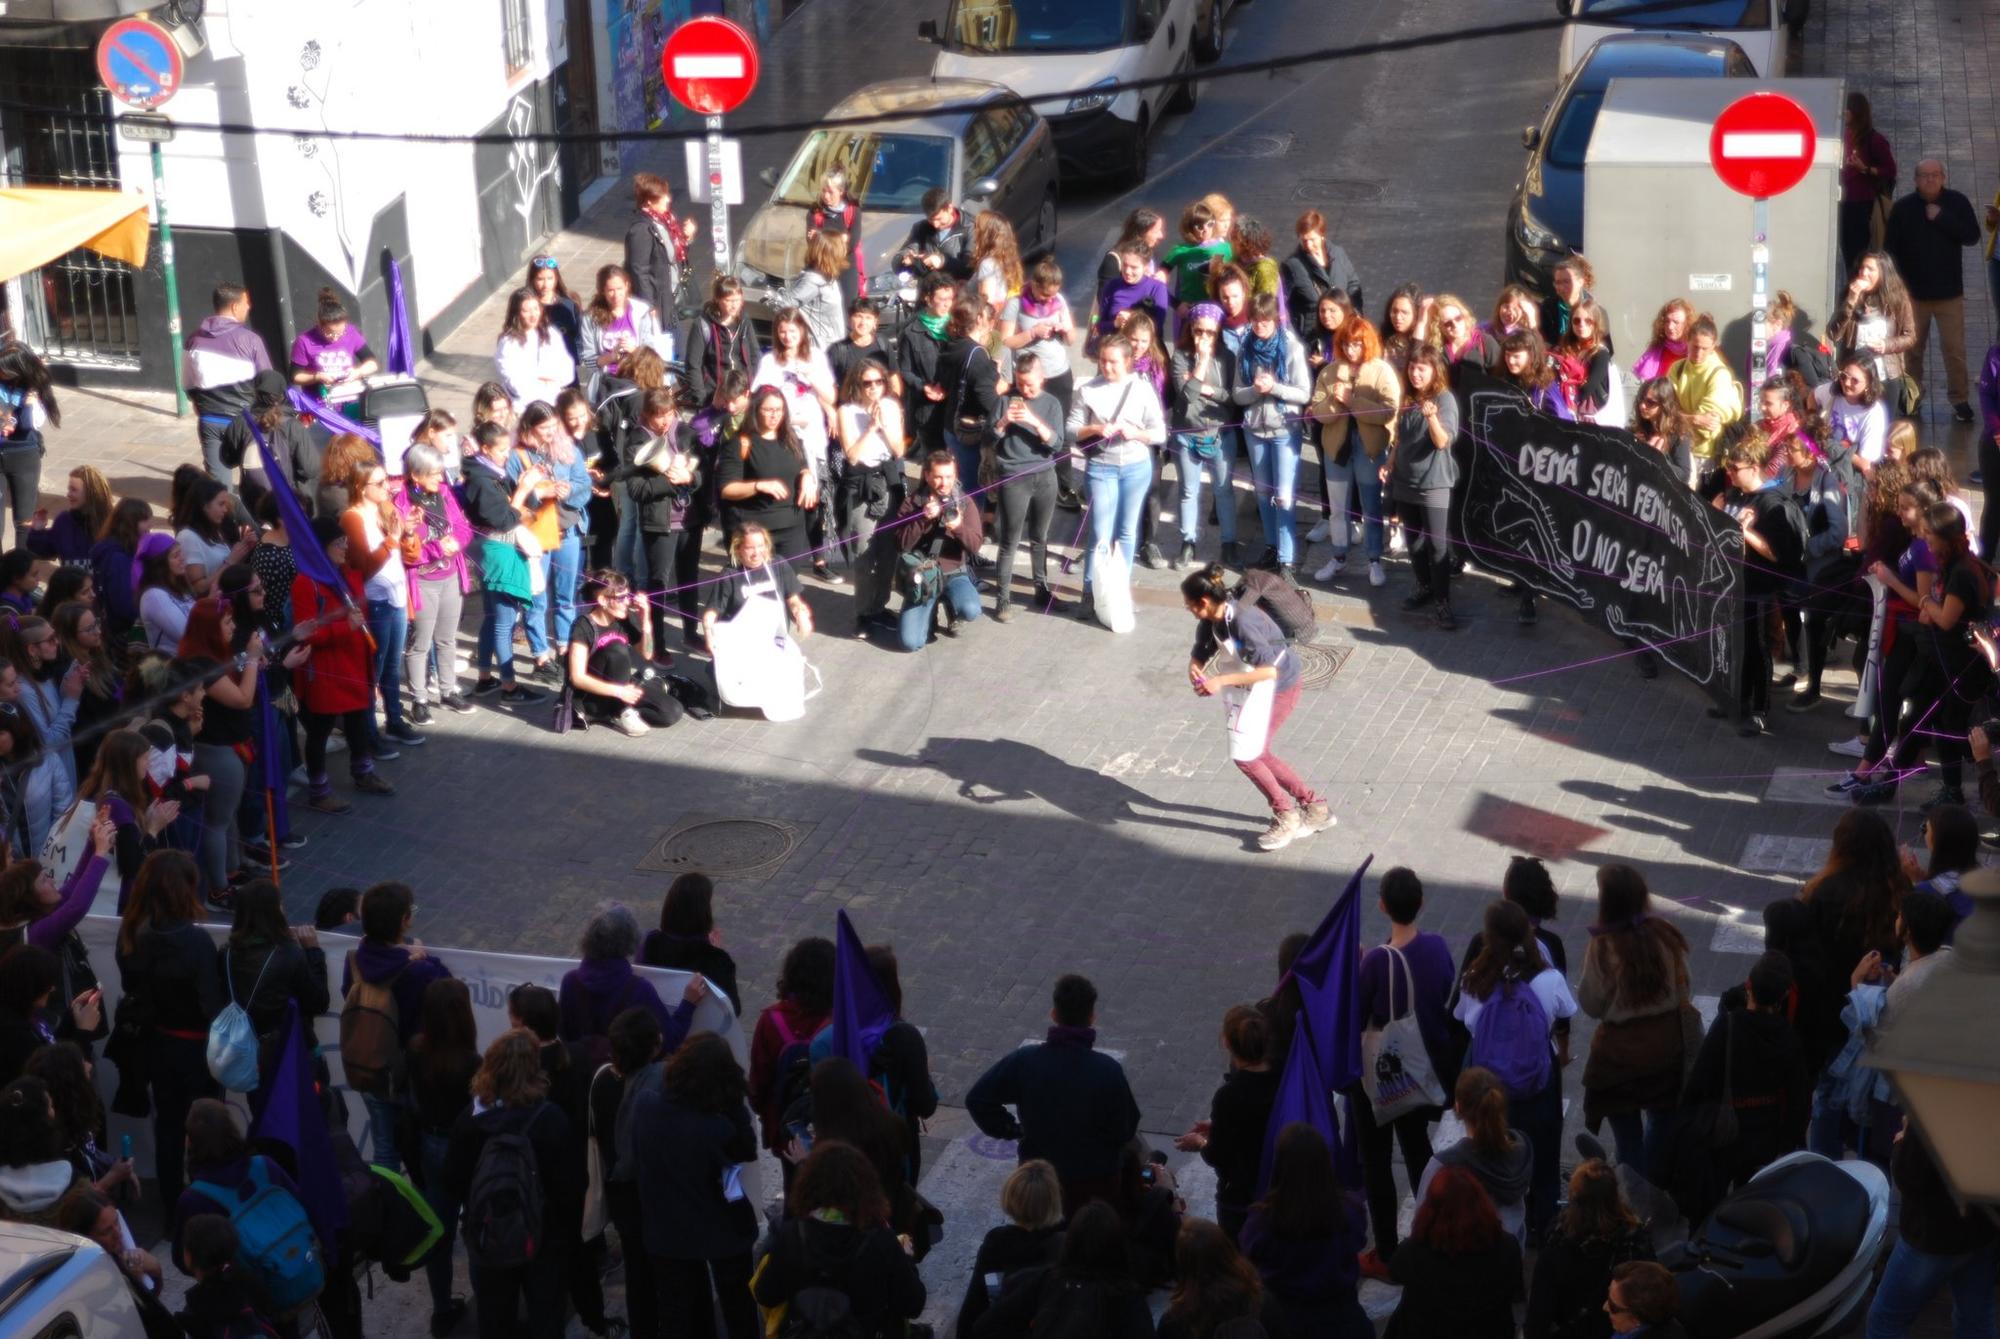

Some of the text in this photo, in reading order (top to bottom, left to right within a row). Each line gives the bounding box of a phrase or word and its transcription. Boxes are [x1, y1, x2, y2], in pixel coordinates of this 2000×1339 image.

[1572, 520, 1592, 561] O
[1592, 534, 1620, 576] NO
[1633, 484, 1690, 558] FEMINISTA
